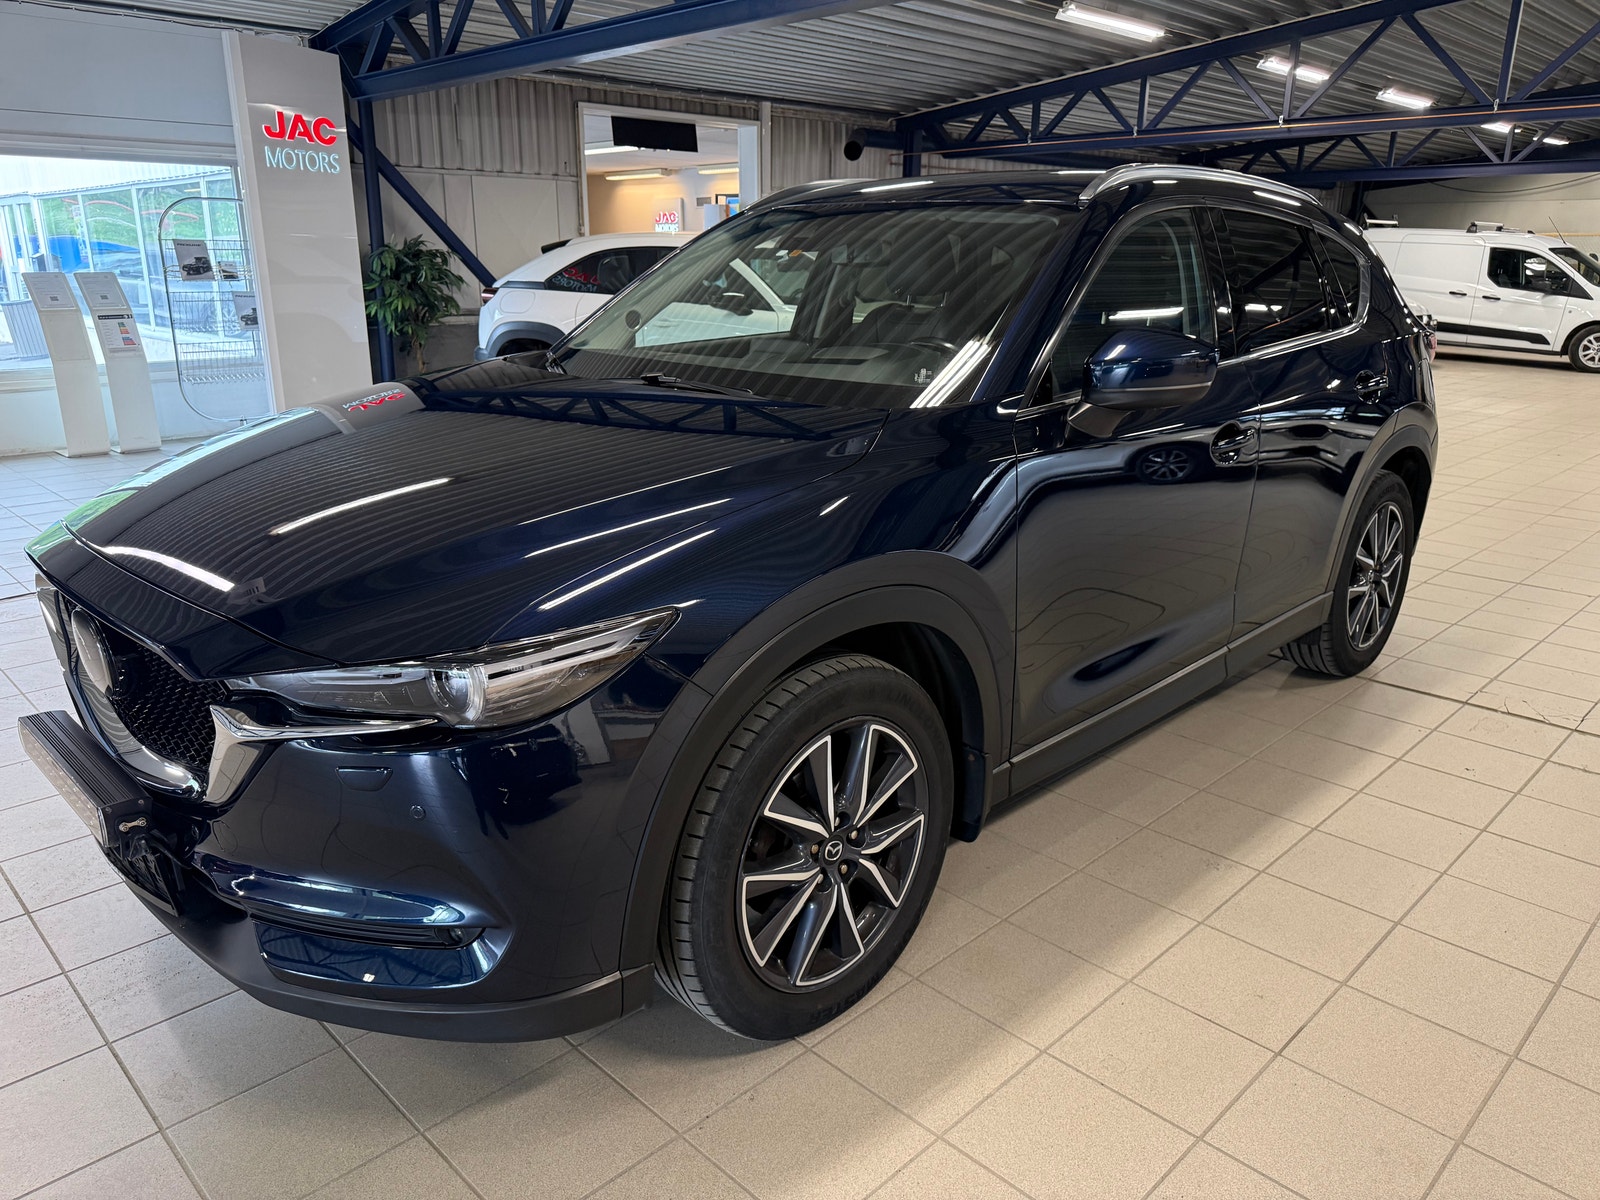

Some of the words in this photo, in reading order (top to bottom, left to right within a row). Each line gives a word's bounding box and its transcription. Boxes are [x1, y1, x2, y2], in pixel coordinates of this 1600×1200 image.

[262, 110, 337, 147] JAC
[264, 146, 340, 174] MOTORS
[655, 211, 678, 224] JAC
